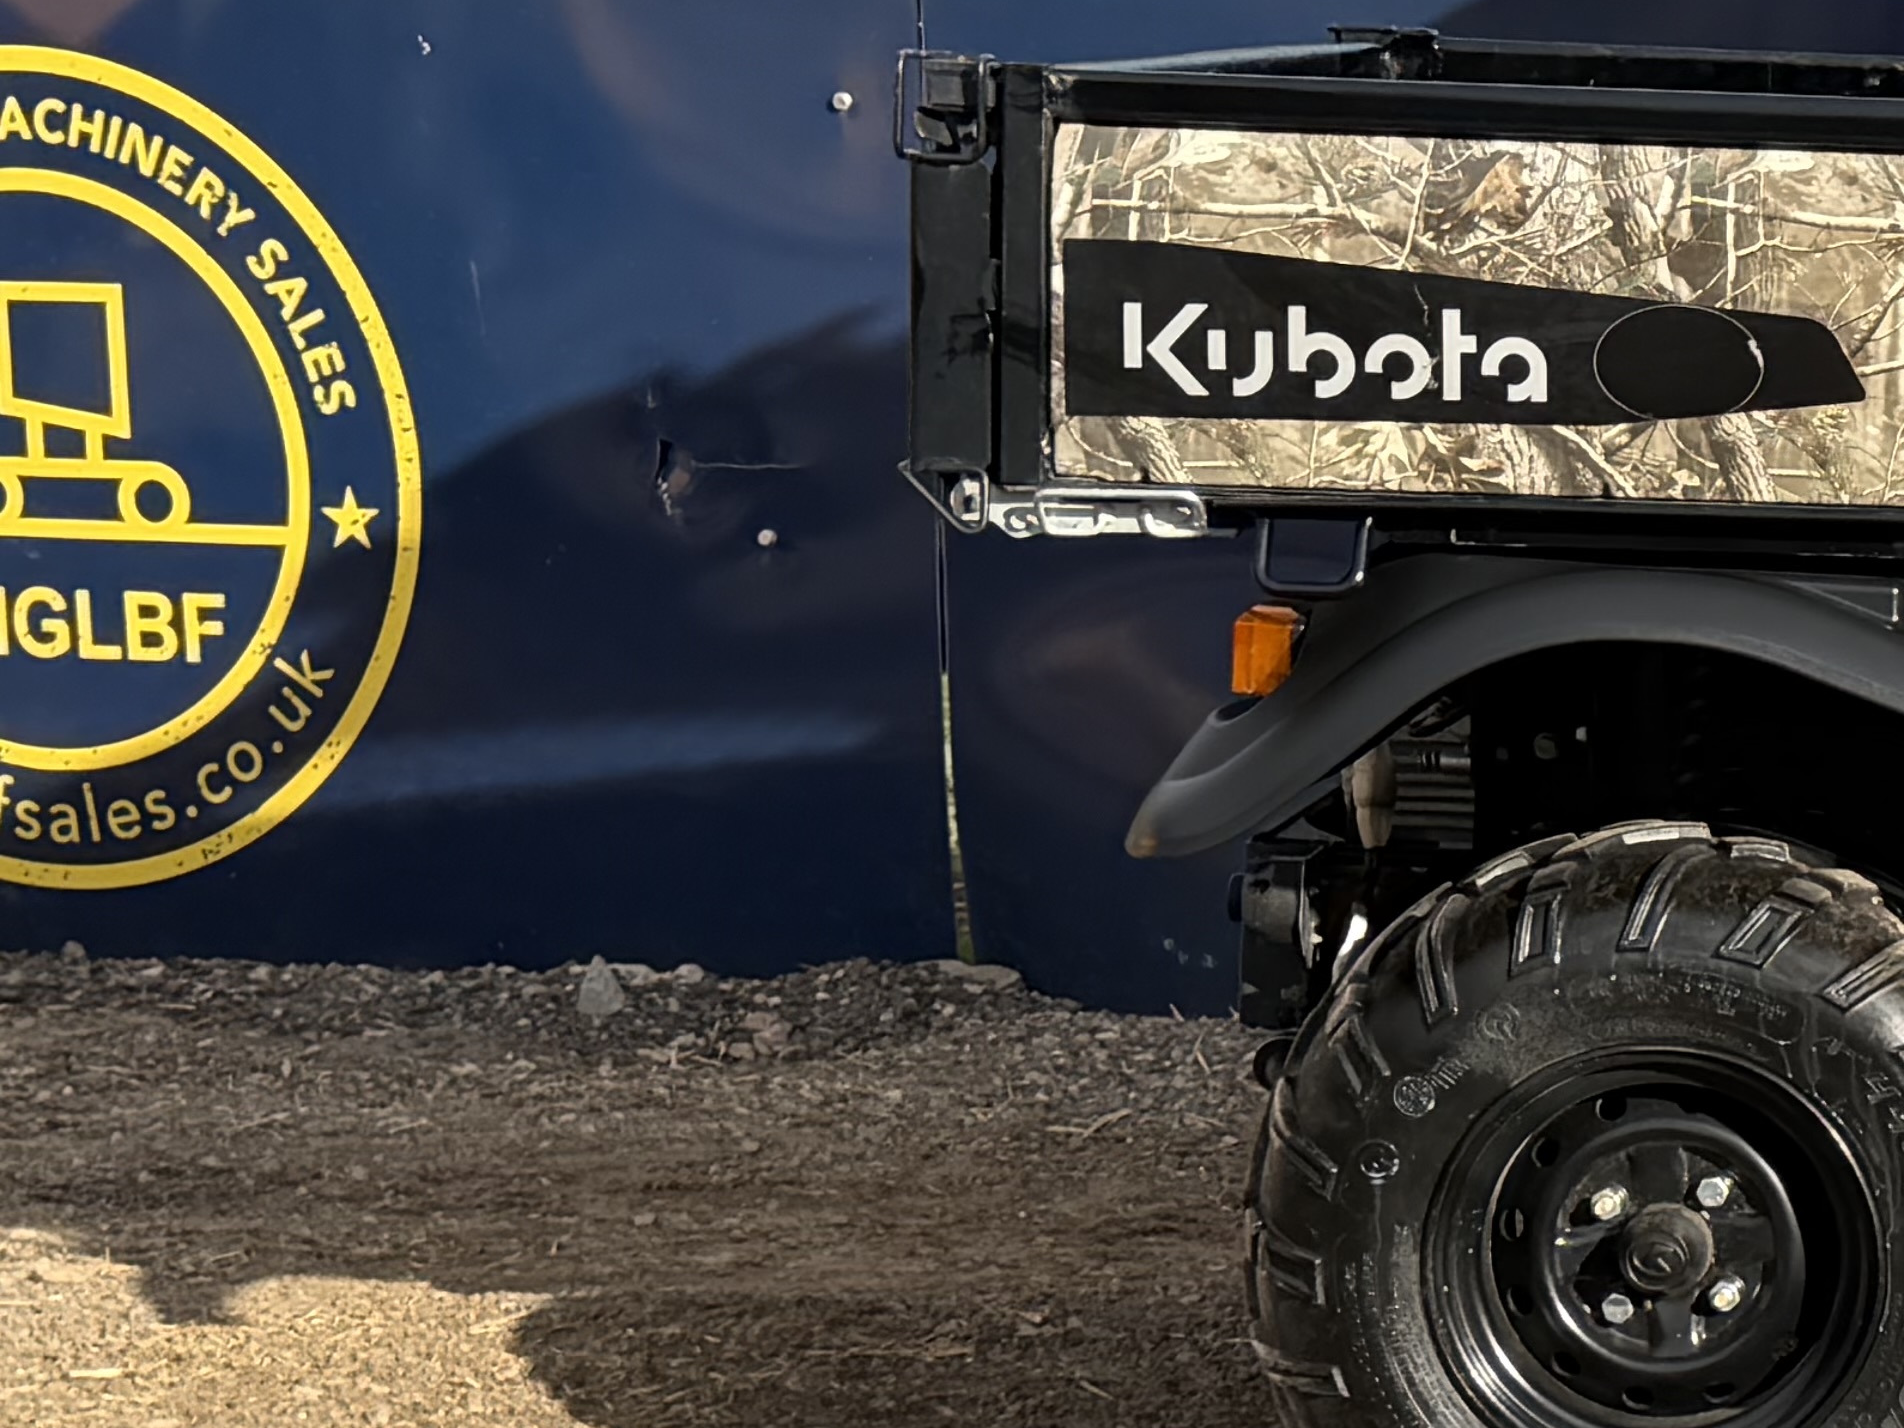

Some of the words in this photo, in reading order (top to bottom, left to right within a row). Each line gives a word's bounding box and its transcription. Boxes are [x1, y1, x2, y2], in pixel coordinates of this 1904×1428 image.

[0, 96, 256, 237] ACHINERY
[246, 239, 357, 415] SALES
[1123, 301, 1548, 403] Kubota
[0, 649, 335, 844] fsales.co.uk
